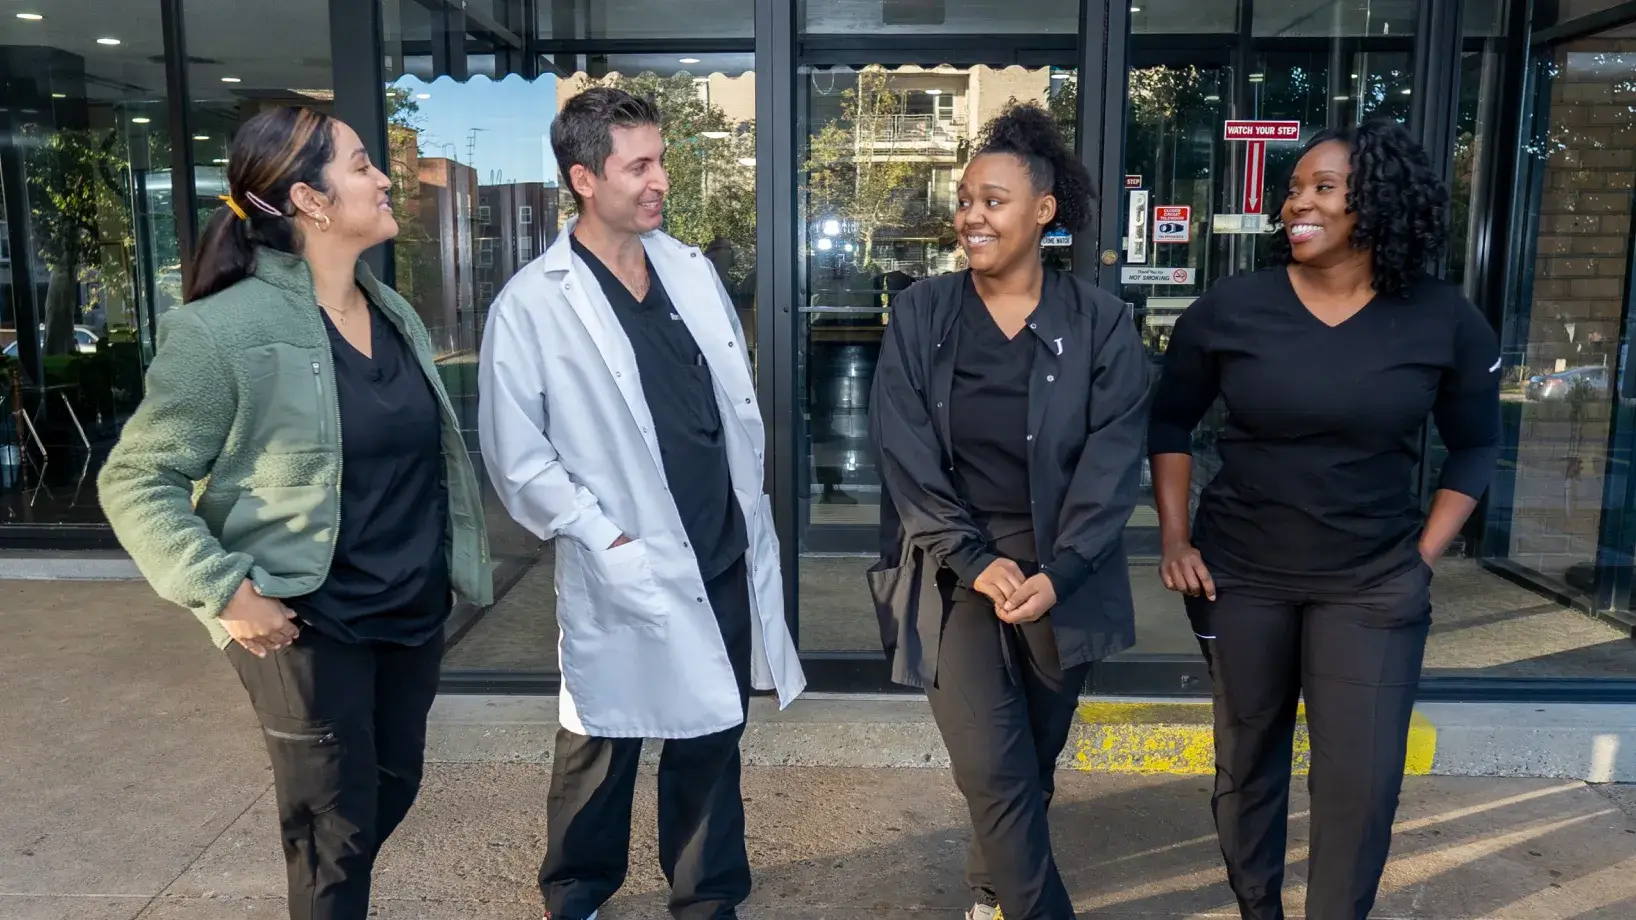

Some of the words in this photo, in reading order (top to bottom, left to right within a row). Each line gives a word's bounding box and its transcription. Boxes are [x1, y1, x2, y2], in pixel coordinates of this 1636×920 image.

[1228, 126, 1253, 134] WATCH
[1256, 126, 1276, 134] YOUR
[1278, 126, 1297, 134] STEP
